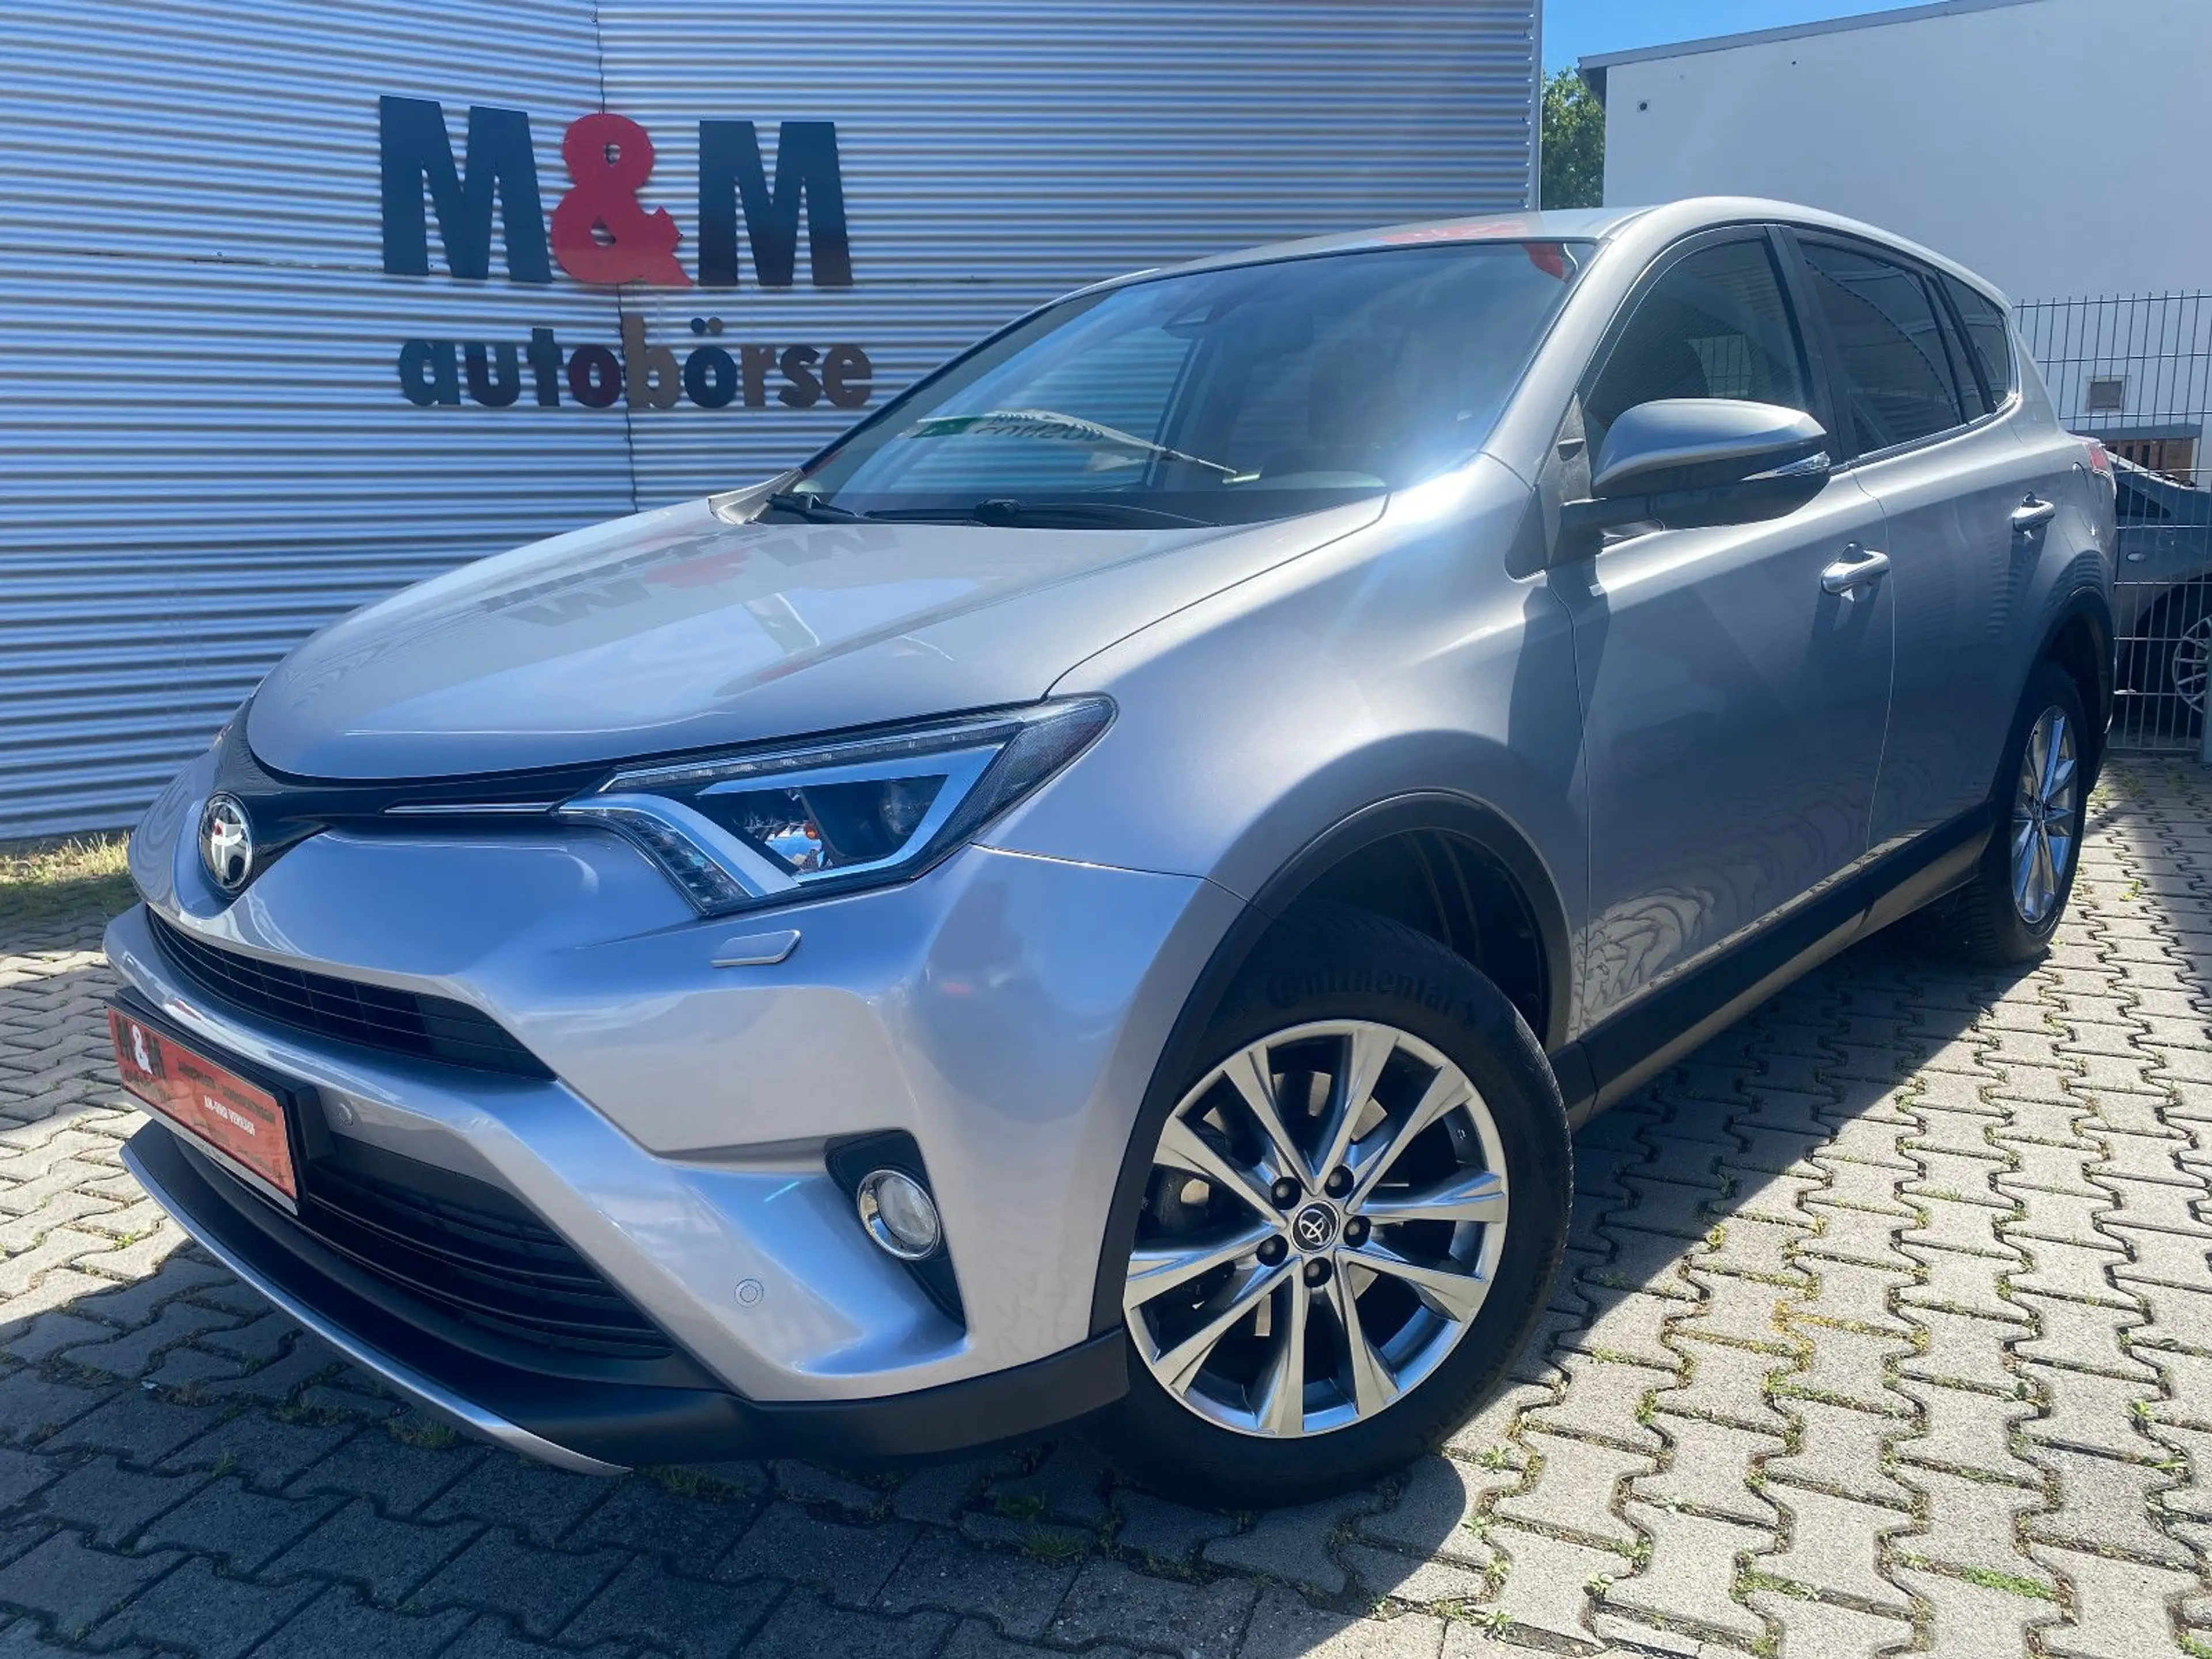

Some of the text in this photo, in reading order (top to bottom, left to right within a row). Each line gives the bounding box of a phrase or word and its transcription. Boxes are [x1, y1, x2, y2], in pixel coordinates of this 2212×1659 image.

[380, 94, 854, 286] M&M
[397, 312, 872, 408] autobörse
[1266, 968, 1455, 1016] Continental
